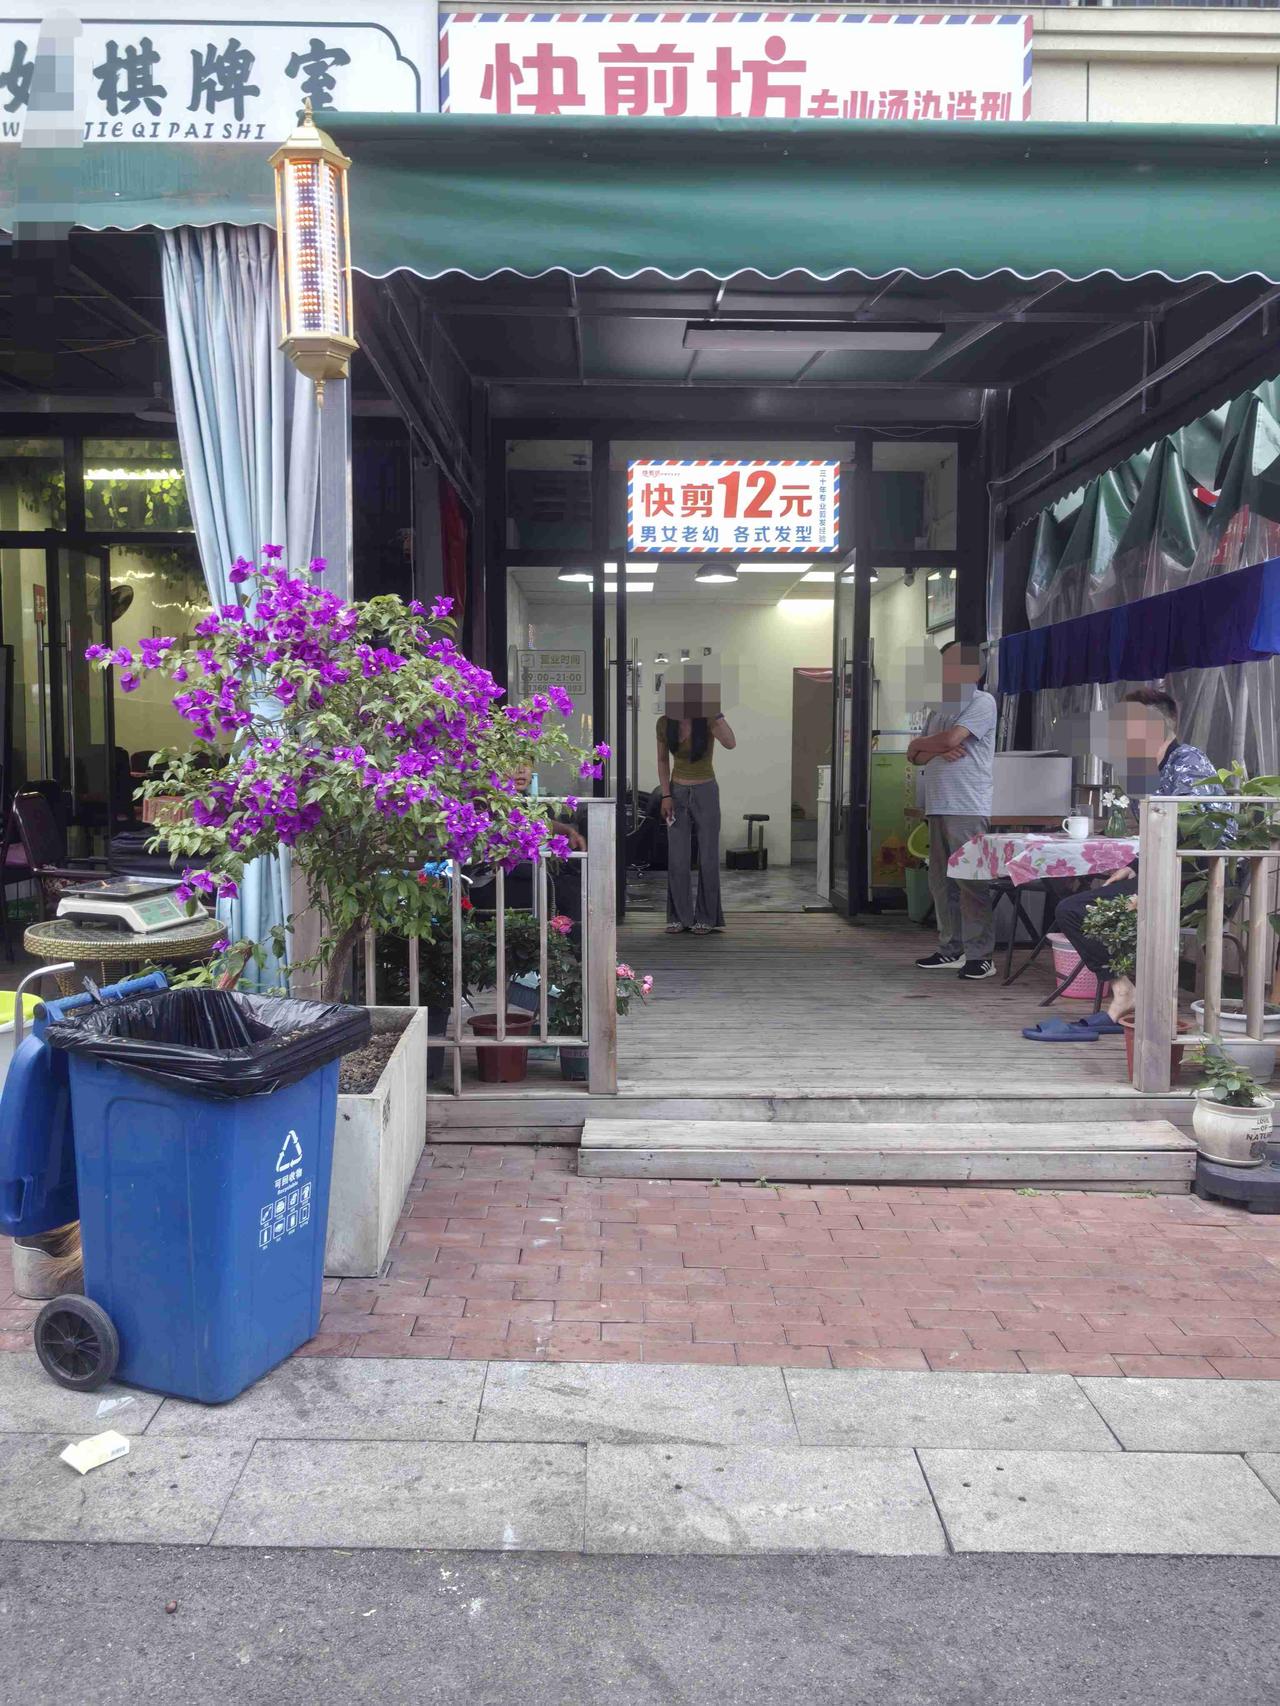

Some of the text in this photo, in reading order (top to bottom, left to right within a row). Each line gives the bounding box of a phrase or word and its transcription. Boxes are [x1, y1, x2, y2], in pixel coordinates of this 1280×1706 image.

[641, 470, 812, 518] 快剪12元
[640, 525, 812, 543] 男女老幼 各式发型
